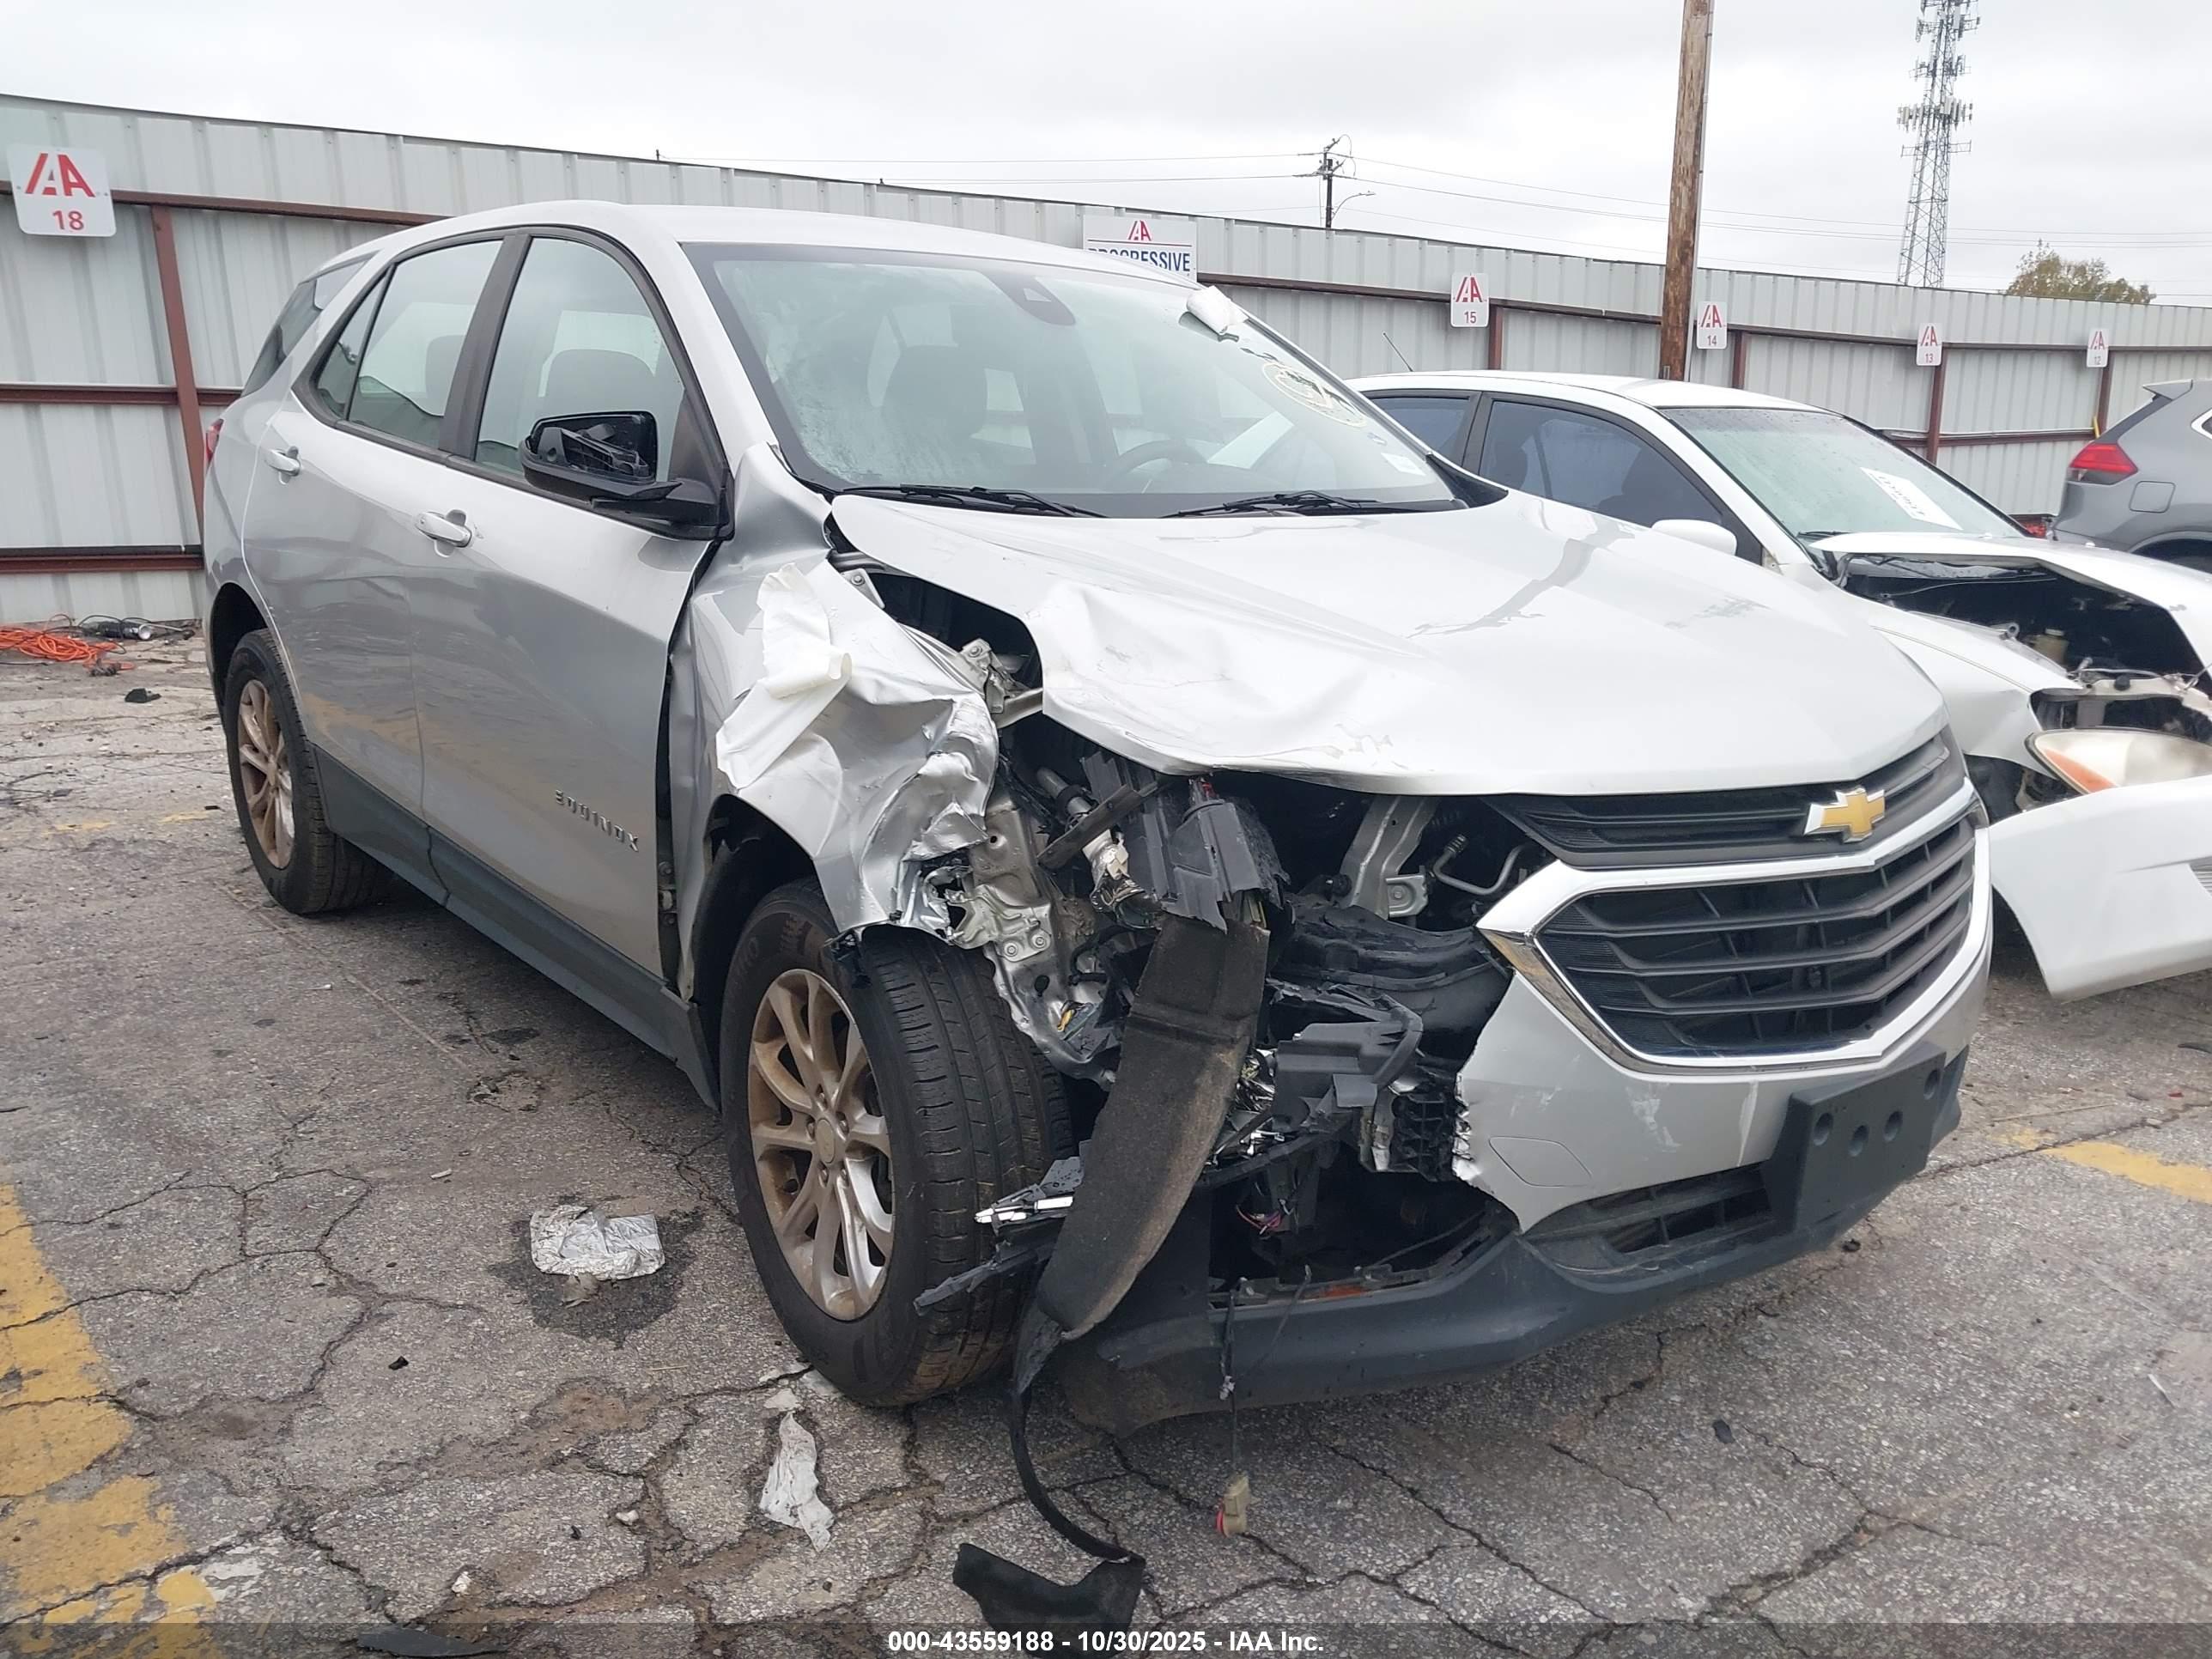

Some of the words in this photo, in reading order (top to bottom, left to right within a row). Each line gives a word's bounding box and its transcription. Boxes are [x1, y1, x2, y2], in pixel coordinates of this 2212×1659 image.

[52, 210, 85, 231] 18
[1464, 310, 1477, 324] 15
[1707, 335, 1717, 346] 14
[1925, 353, 1934, 364] 13
[555, 789, 639, 852] EQUINOX
